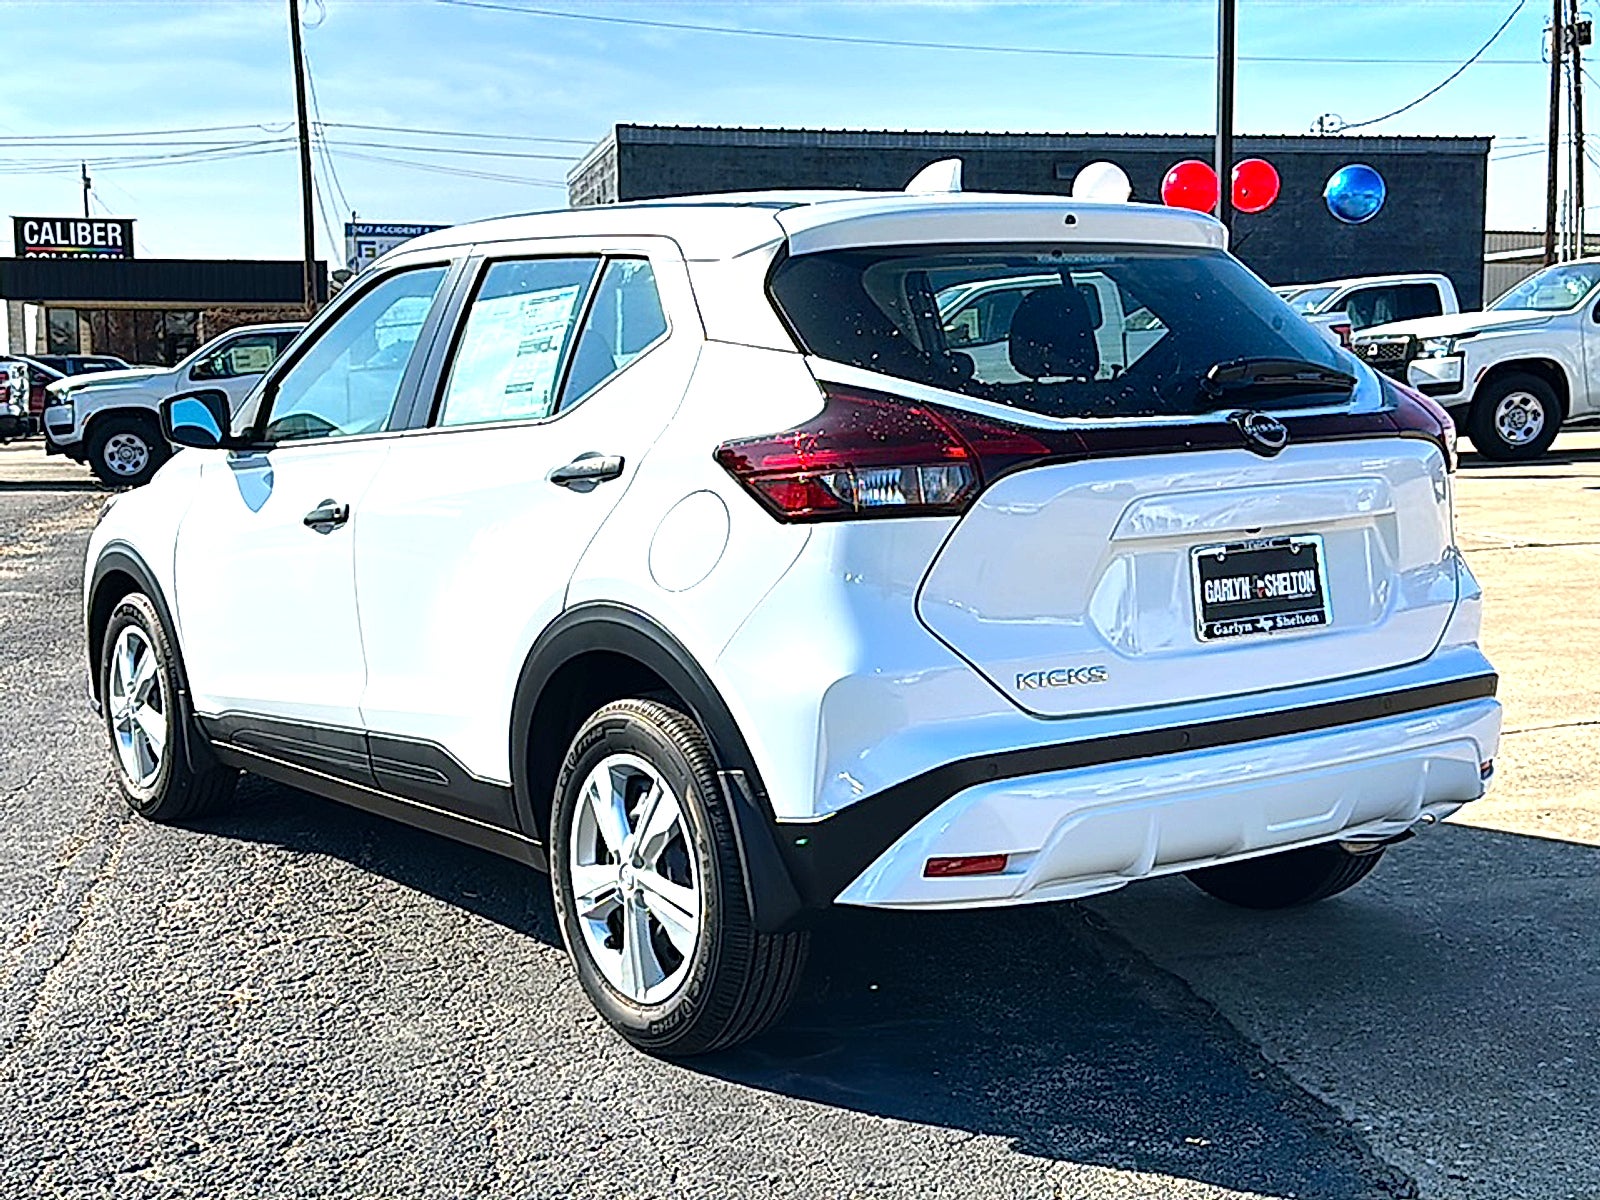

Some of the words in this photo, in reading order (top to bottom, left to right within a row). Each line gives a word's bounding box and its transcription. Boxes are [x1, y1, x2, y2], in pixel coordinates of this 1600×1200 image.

[23, 221, 123, 246] CALIBER
[375, 226, 421, 234] ACCIDENT
[1205, 577, 1251, 604] GARLYN
[1264, 570, 1316, 597] SHELTON
[1213, 623, 1253, 636] Garlyn
[1276, 614, 1319, 628] Shelton
[1016, 665, 1109, 690] KICKS
